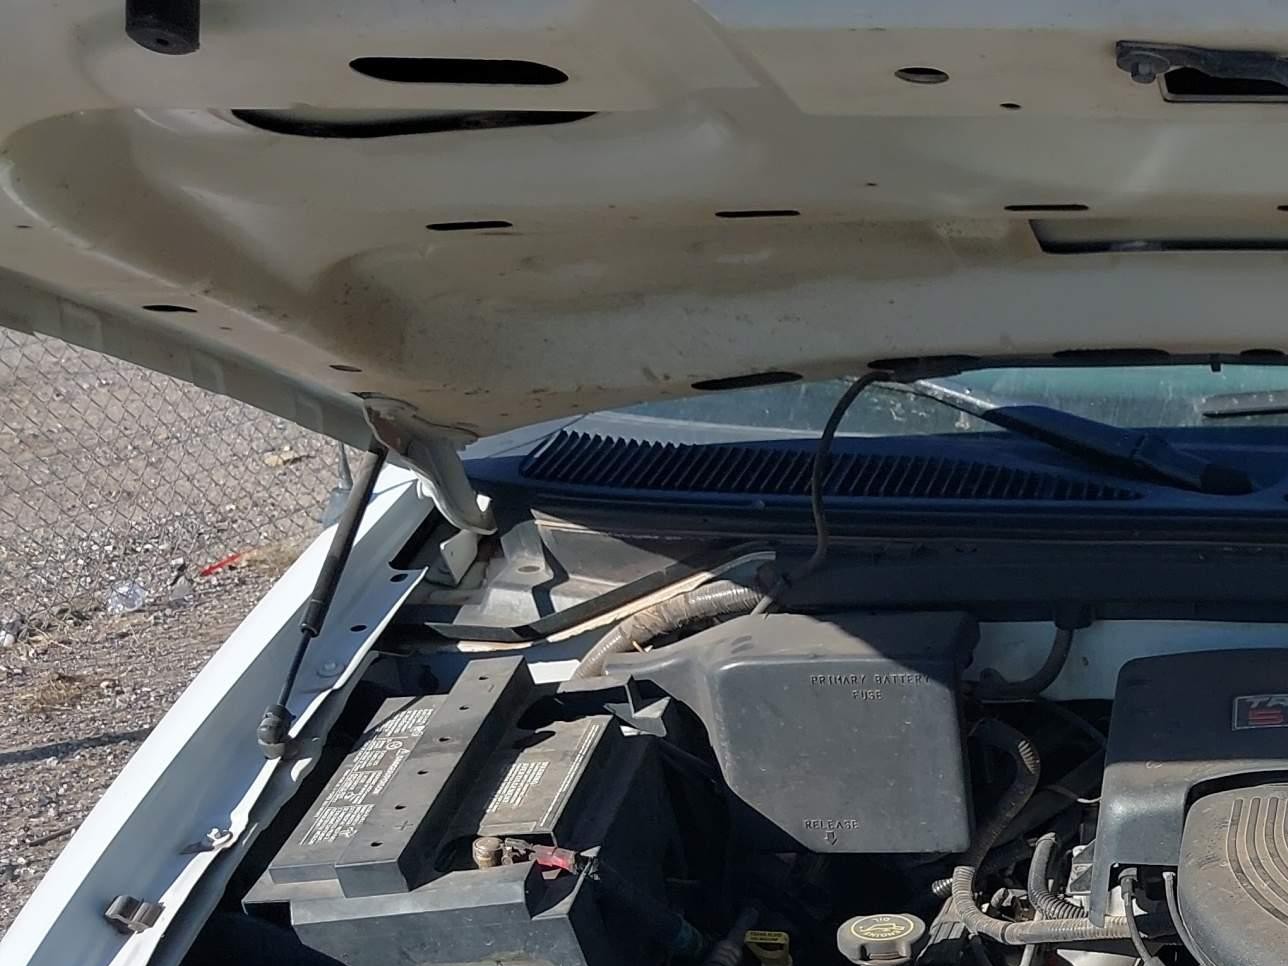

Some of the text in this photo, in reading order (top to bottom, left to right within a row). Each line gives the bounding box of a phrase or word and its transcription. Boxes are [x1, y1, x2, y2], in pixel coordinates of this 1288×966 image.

[810, 674, 932, 685] PRIMARY BATTERY
[852, 690, 884, 701] FUSE
[804, 818, 860, 830] RELEASE
